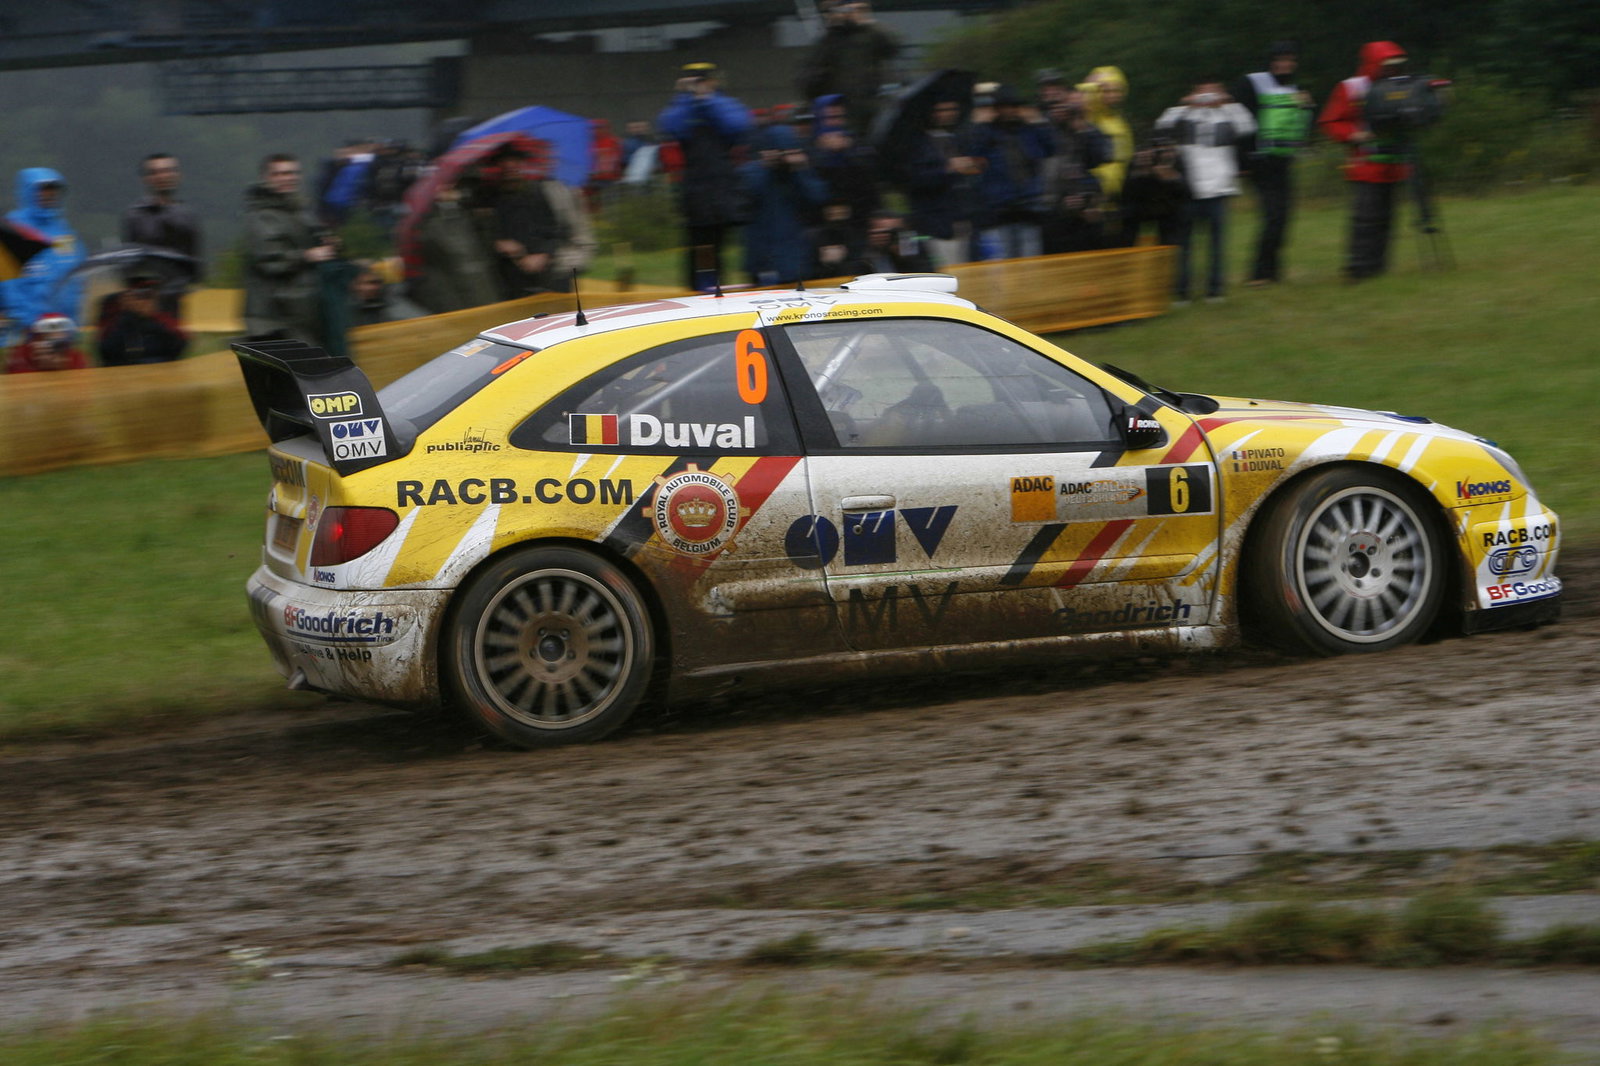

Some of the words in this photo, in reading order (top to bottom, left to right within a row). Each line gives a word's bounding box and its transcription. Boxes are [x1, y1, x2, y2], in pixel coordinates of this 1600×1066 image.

[766, 308, 883, 322] www.kronosracing.com
[735, 328, 768, 404] 6
[311, 395, 357, 414] OMP
[630, 413, 755, 448] Duval
[336, 440, 382, 459] OMV
[1247, 448, 1285, 459] PIVATO
[1249, 460, 1285, 472] DUVAL
[397, 478, 633, 507] RACB.COM
[1013, 478, 1053, 494] ADAC
[1060, 482, 1092, 495] ADAC
[1169, 467, 1189, 513] 6
[1456, 476, 1511, 499] KRONOS
[657, 495, 669, 529] ROYAL
[666, 475, 731, 497] AUTOMOBILE
[726, 499, 737, 529] CLUB
[672, 538, 722, 553] BELGIUM
[284, 604, 394, 634] BFGoodrich
[337, 648, 372, 662] Help
